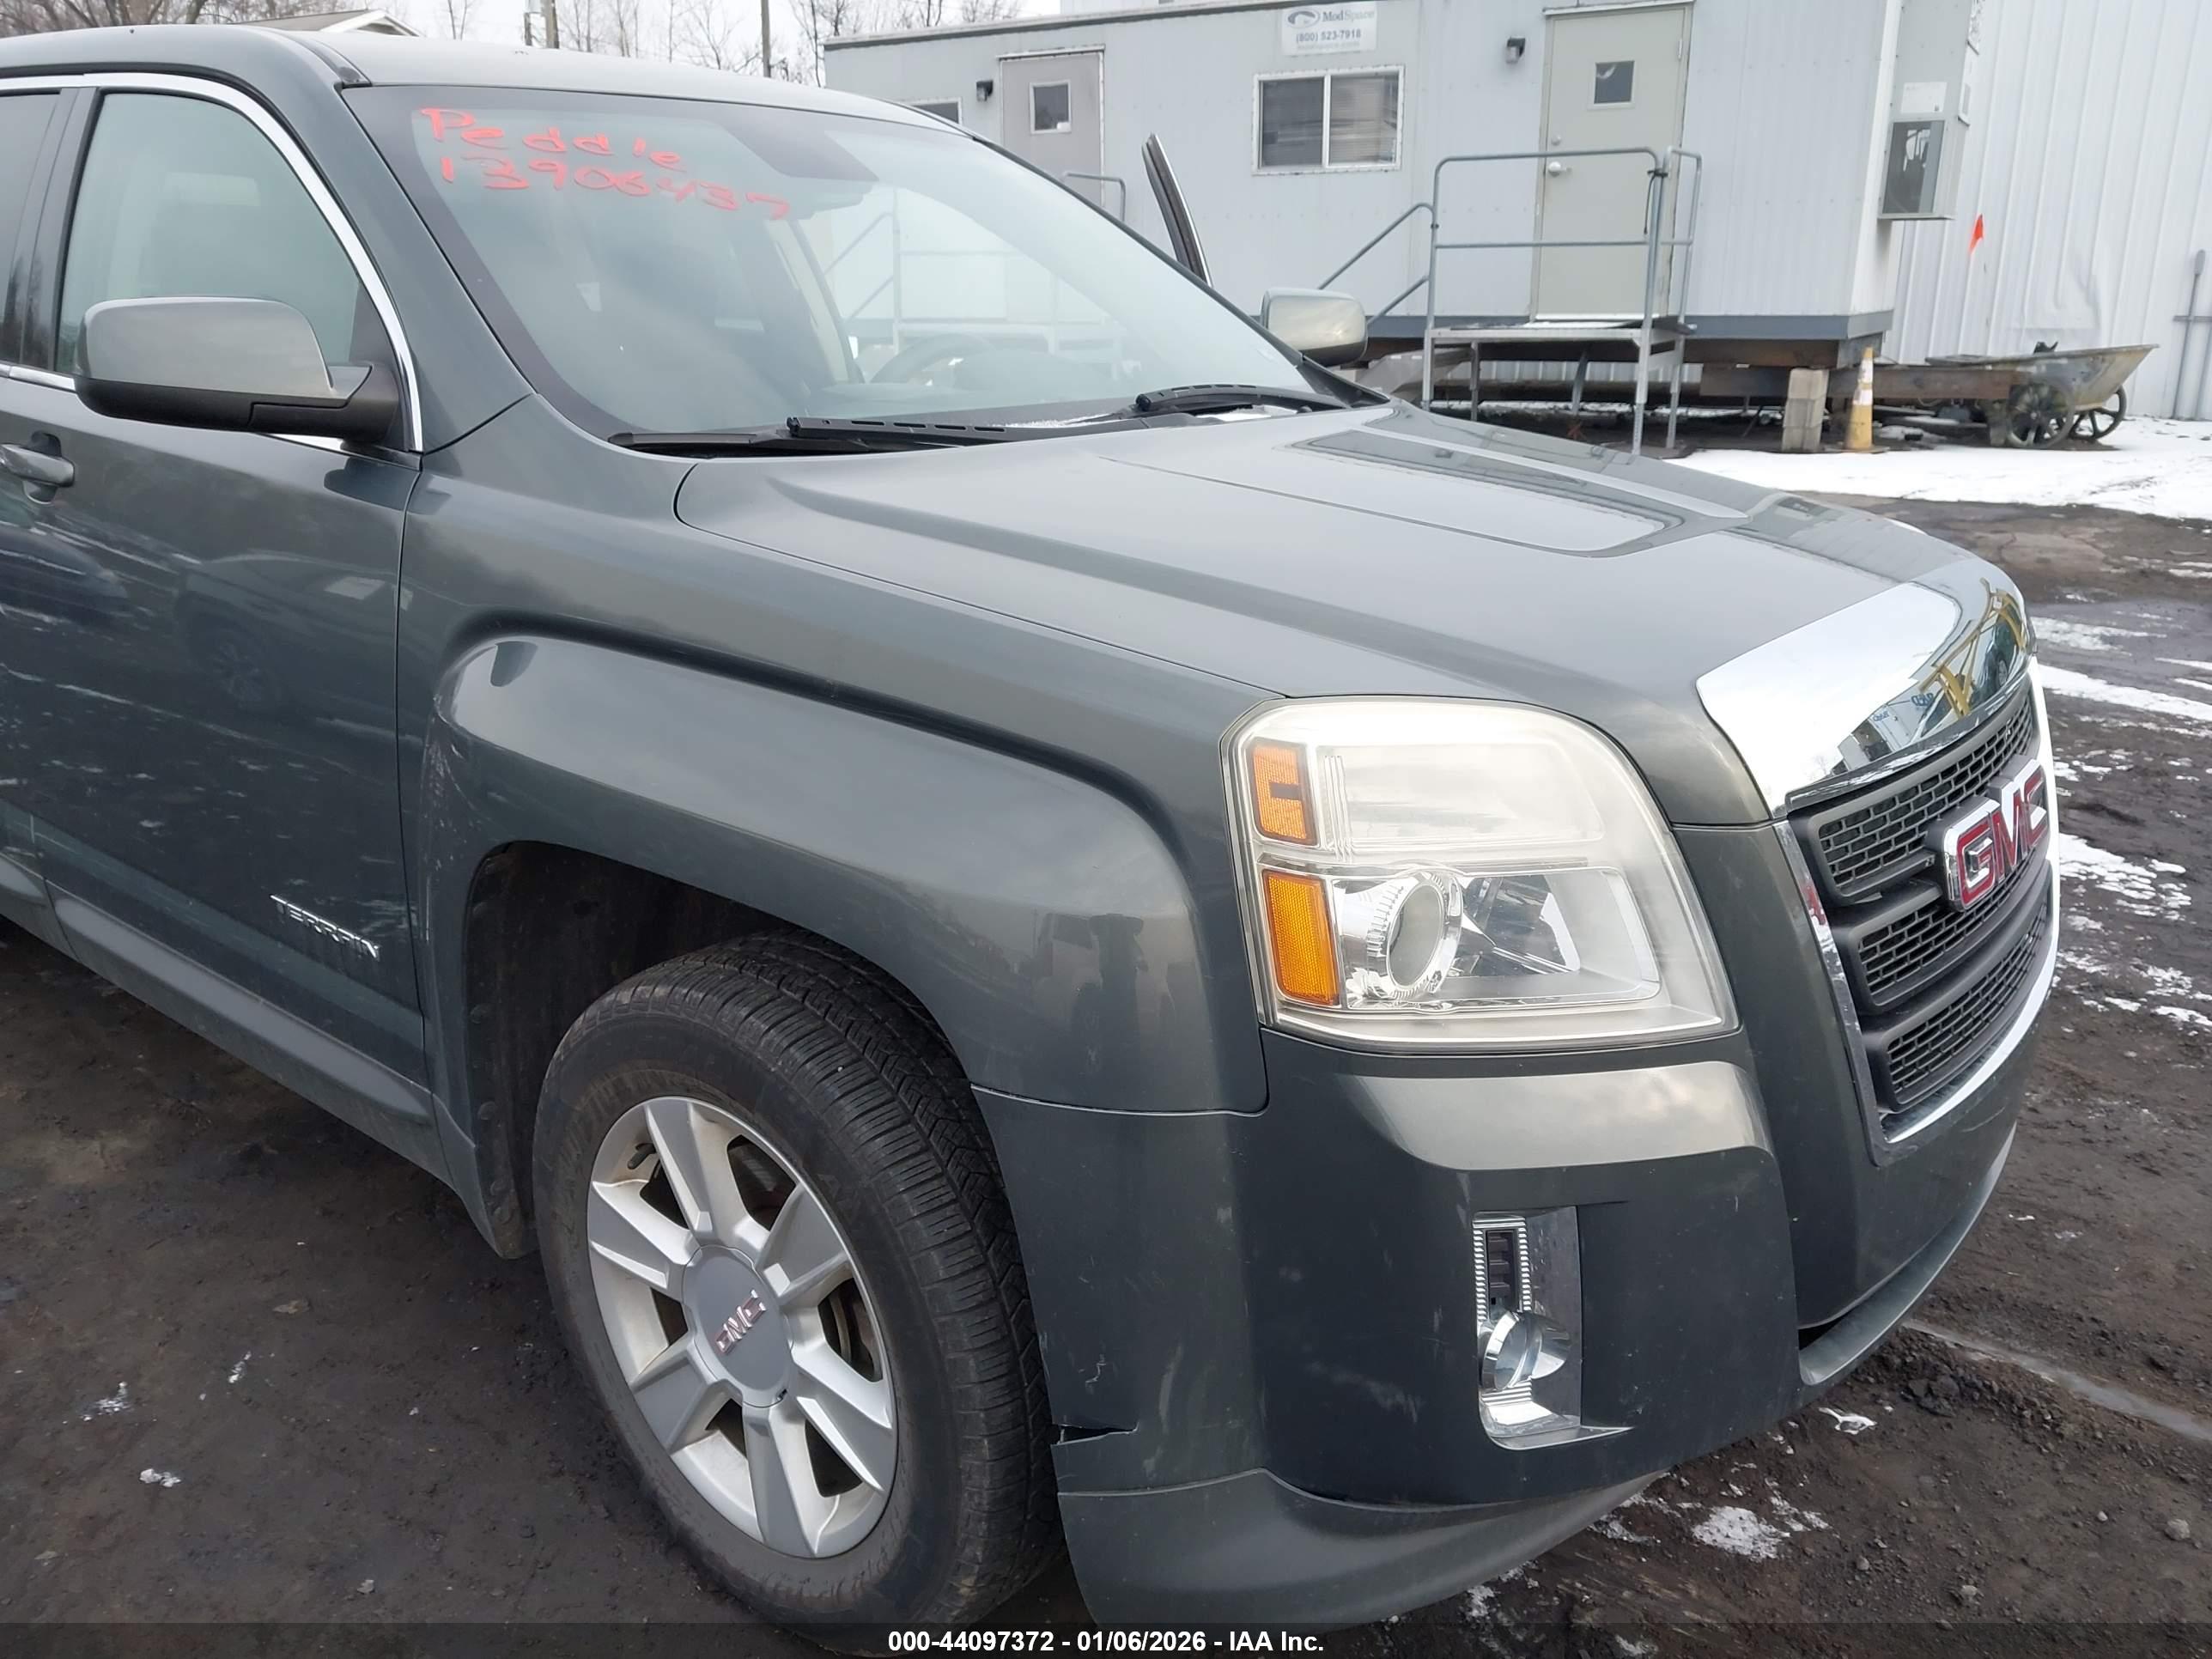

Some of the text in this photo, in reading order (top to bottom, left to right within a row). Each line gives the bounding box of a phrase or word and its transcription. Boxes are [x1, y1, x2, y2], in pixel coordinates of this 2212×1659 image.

[420, 107, 688, 173] Peddle
[1944, 758, 2051, 910] GMC
[714, 1289, 767, 1354] GMC
